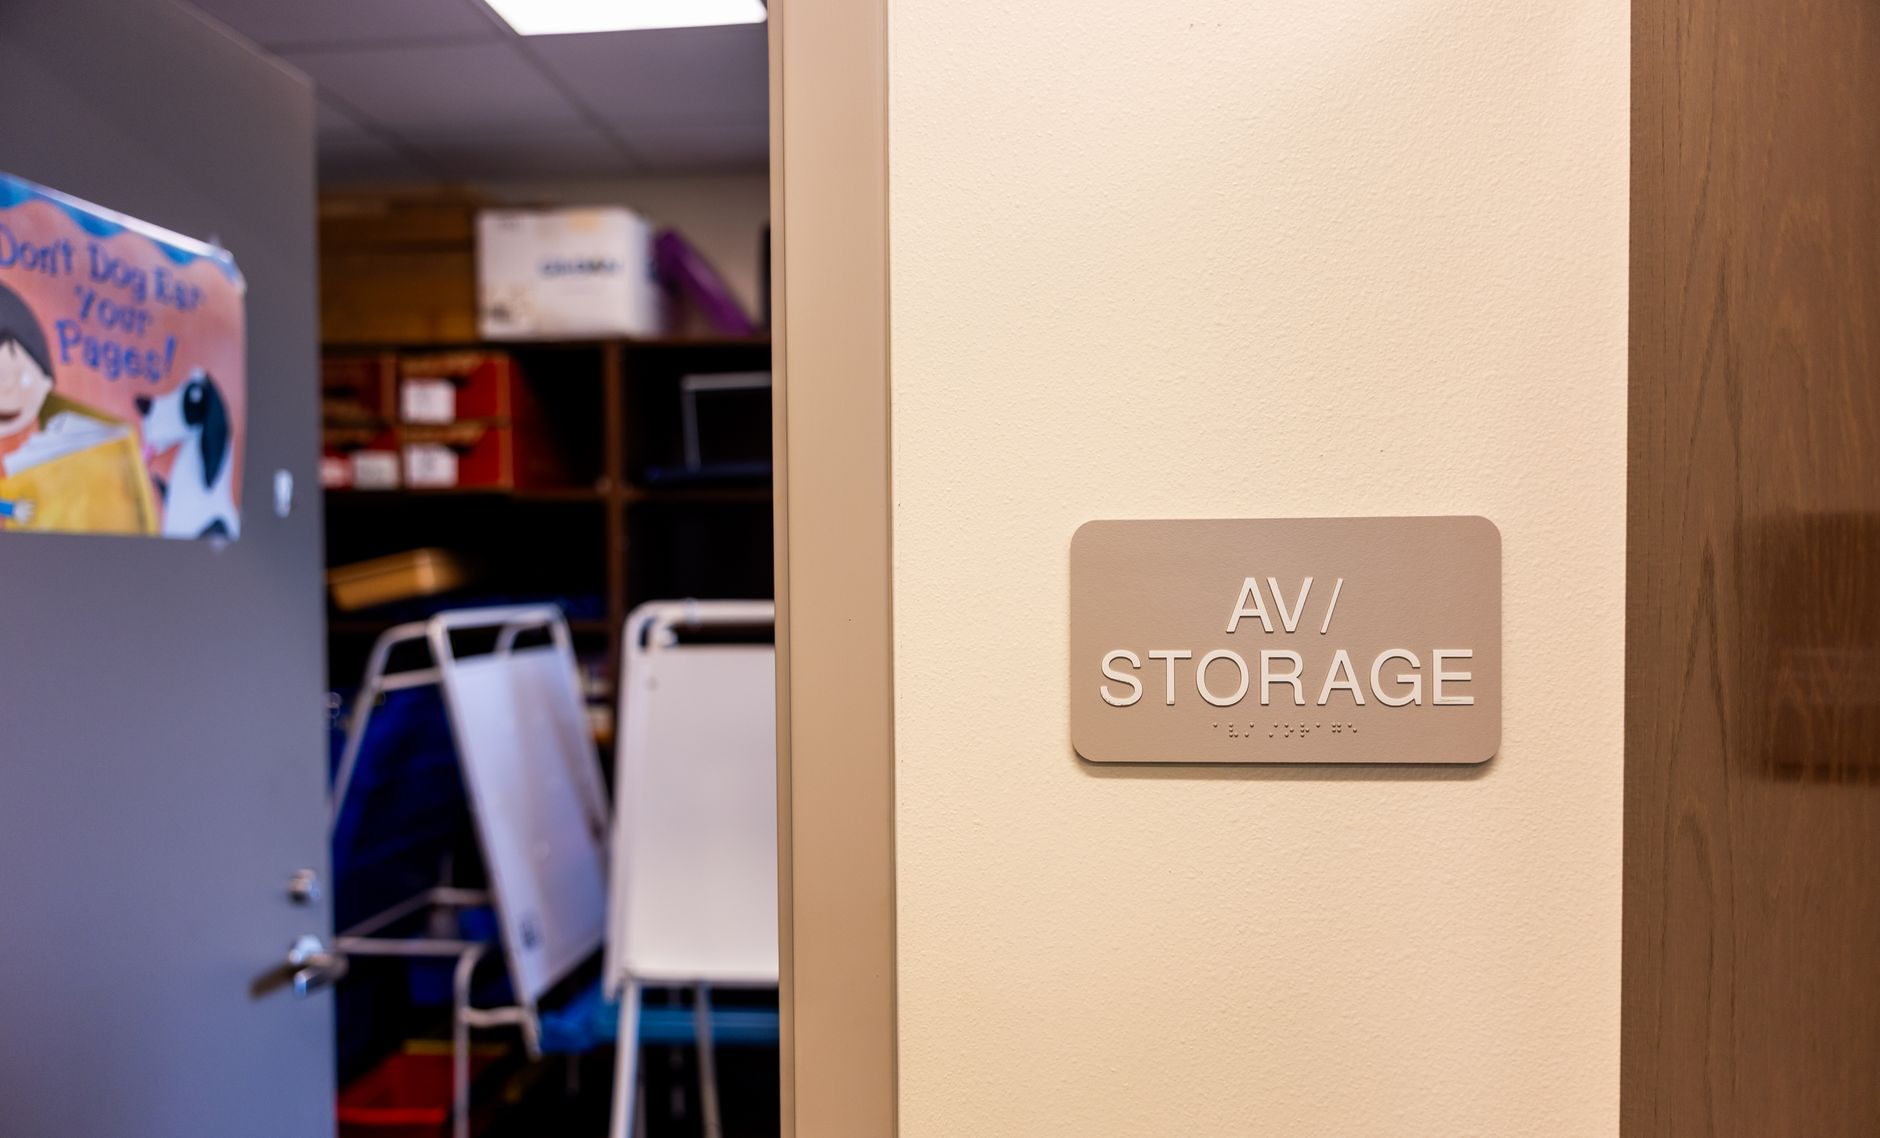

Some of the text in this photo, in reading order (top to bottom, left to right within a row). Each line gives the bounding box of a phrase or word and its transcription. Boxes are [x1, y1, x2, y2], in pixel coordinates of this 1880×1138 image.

[0, 224, 203, 311] Don't Dog Ear
[74, 284, 149, 337] Your
[56, 319, 177, 383] Pages!
[1100, 649, 1474, 707] STORAGE
